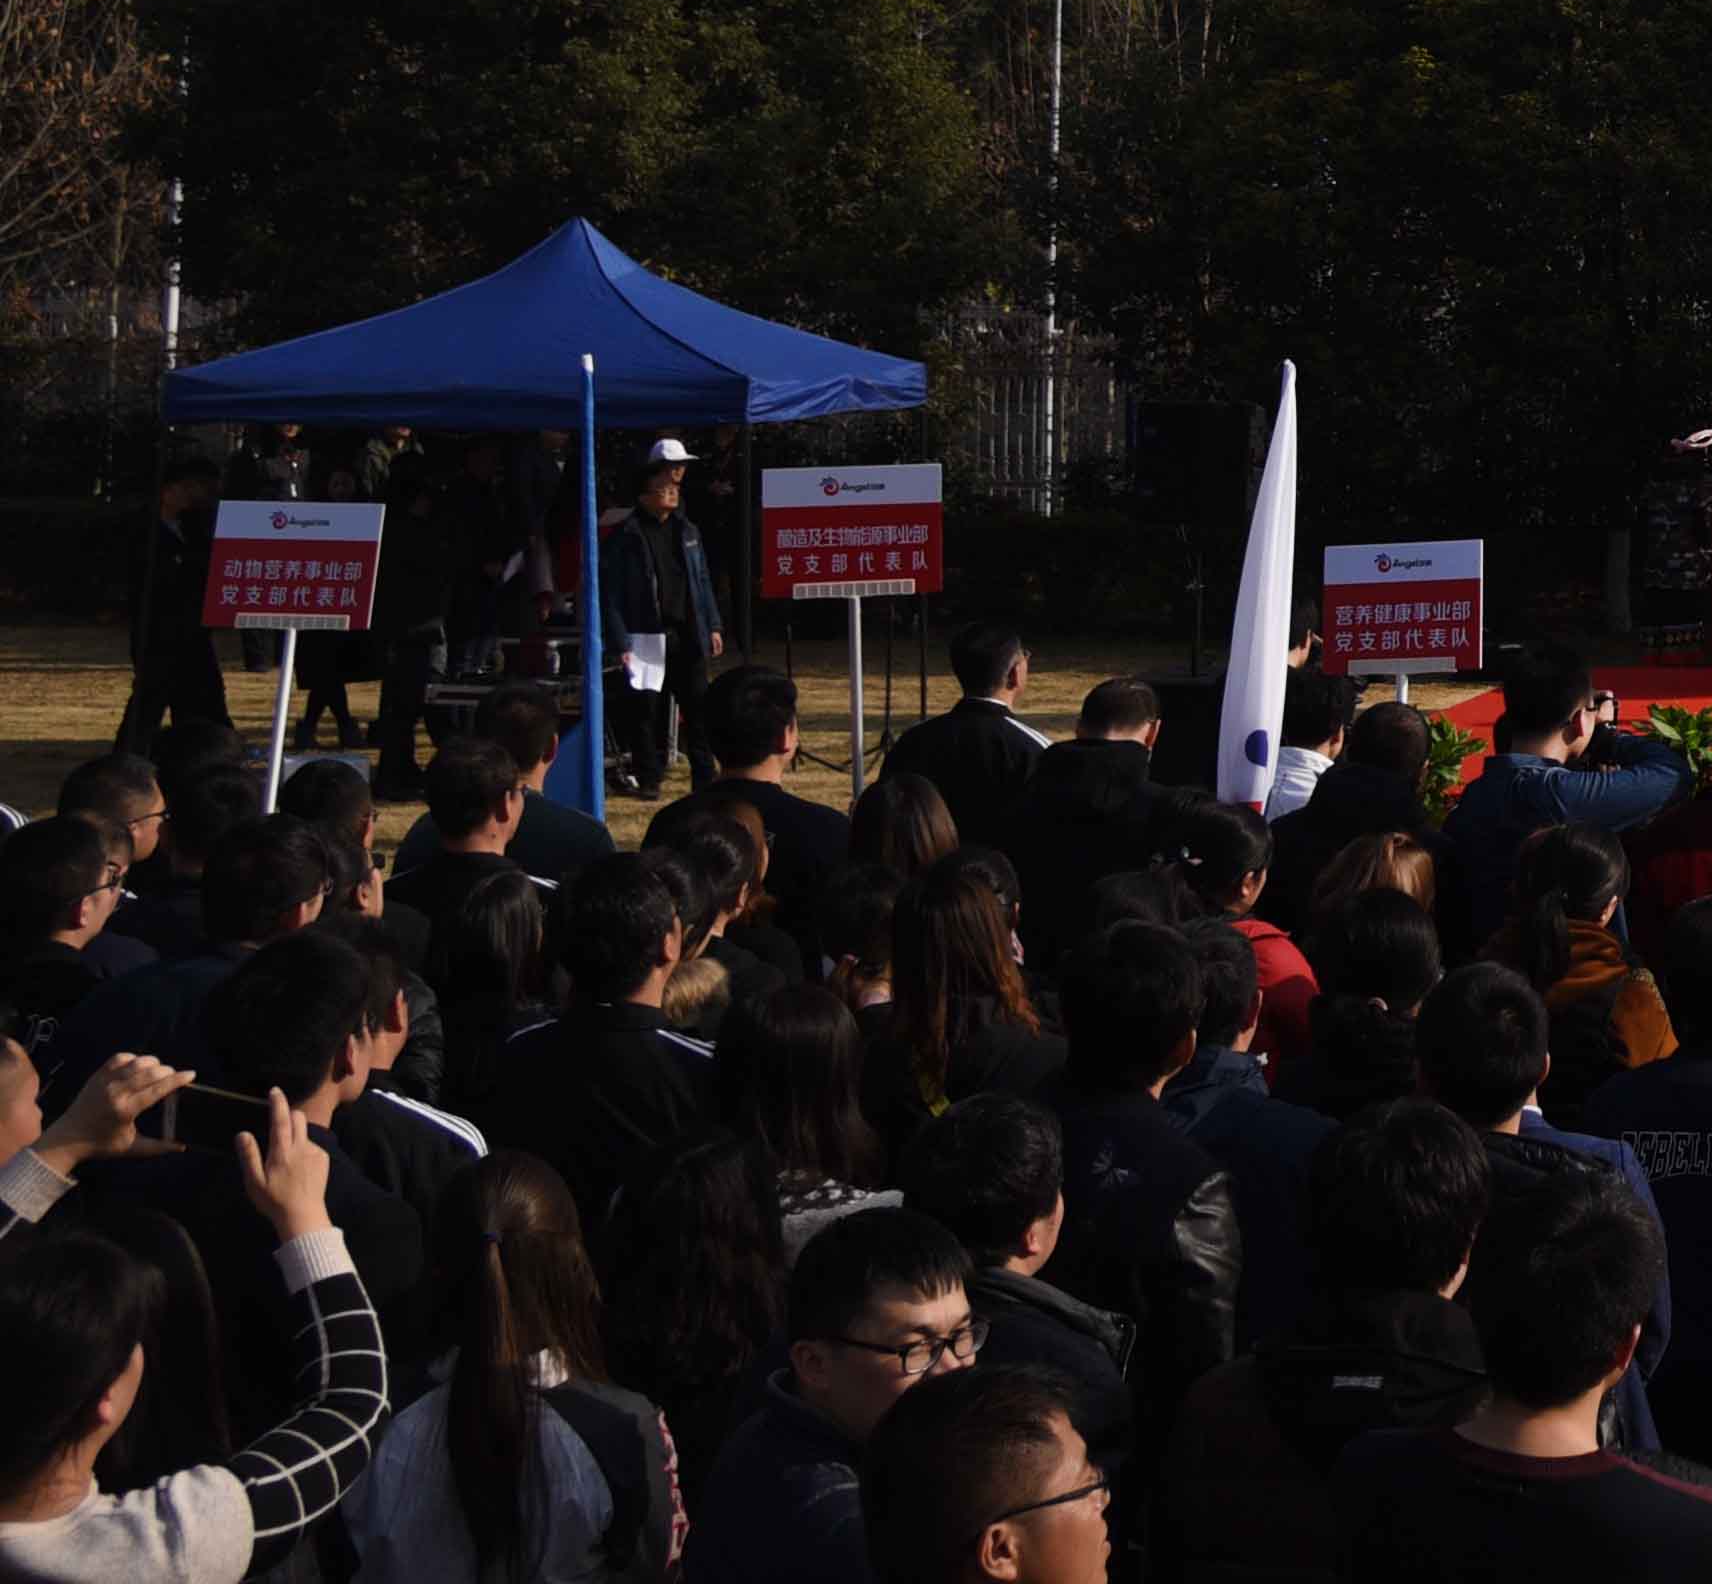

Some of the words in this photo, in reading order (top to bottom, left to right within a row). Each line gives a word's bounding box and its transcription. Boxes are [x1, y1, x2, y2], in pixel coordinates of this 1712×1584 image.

[224, 559, 362, 582] 动物营养事业部
[776, 548, 929, 577] 党支部代表队
[219, 585, 359, 608] 党支部代表队
[1335, 600, 1472, 626] 营养健康事业部
[1335, 626, 1471, 653] 党支部代表队
